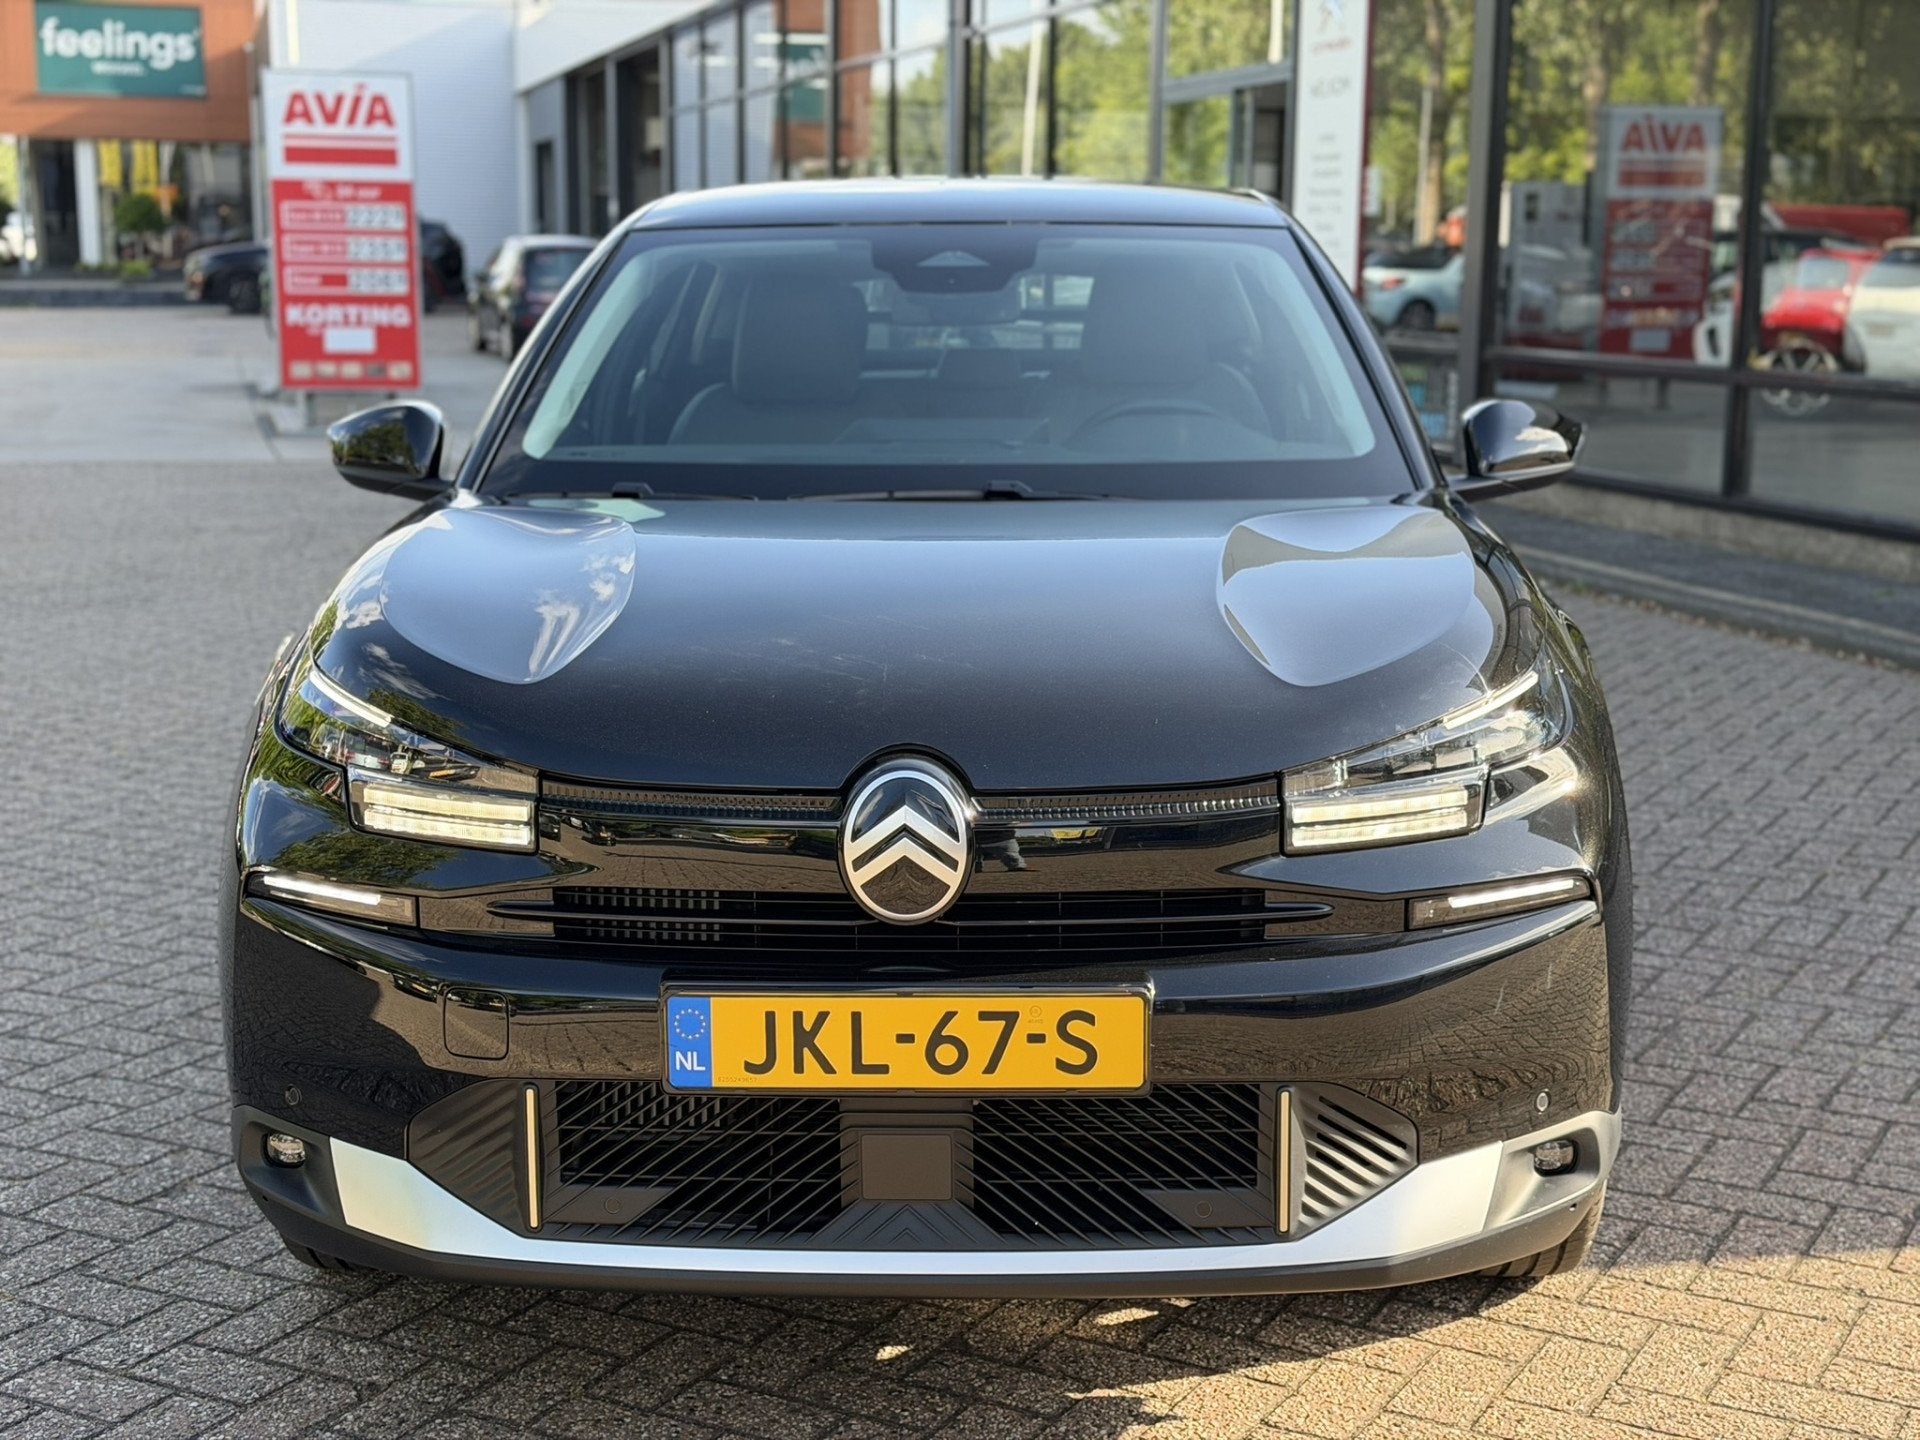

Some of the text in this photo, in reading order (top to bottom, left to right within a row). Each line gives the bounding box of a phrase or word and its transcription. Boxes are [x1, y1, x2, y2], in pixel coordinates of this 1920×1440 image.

[40, 16, 196, 70] feelings
[286, 303, 411, 328] KORTING
[675, 1051, 706, 1071] NL
[744, 1009, 1098, 1076] JKL-67-S
